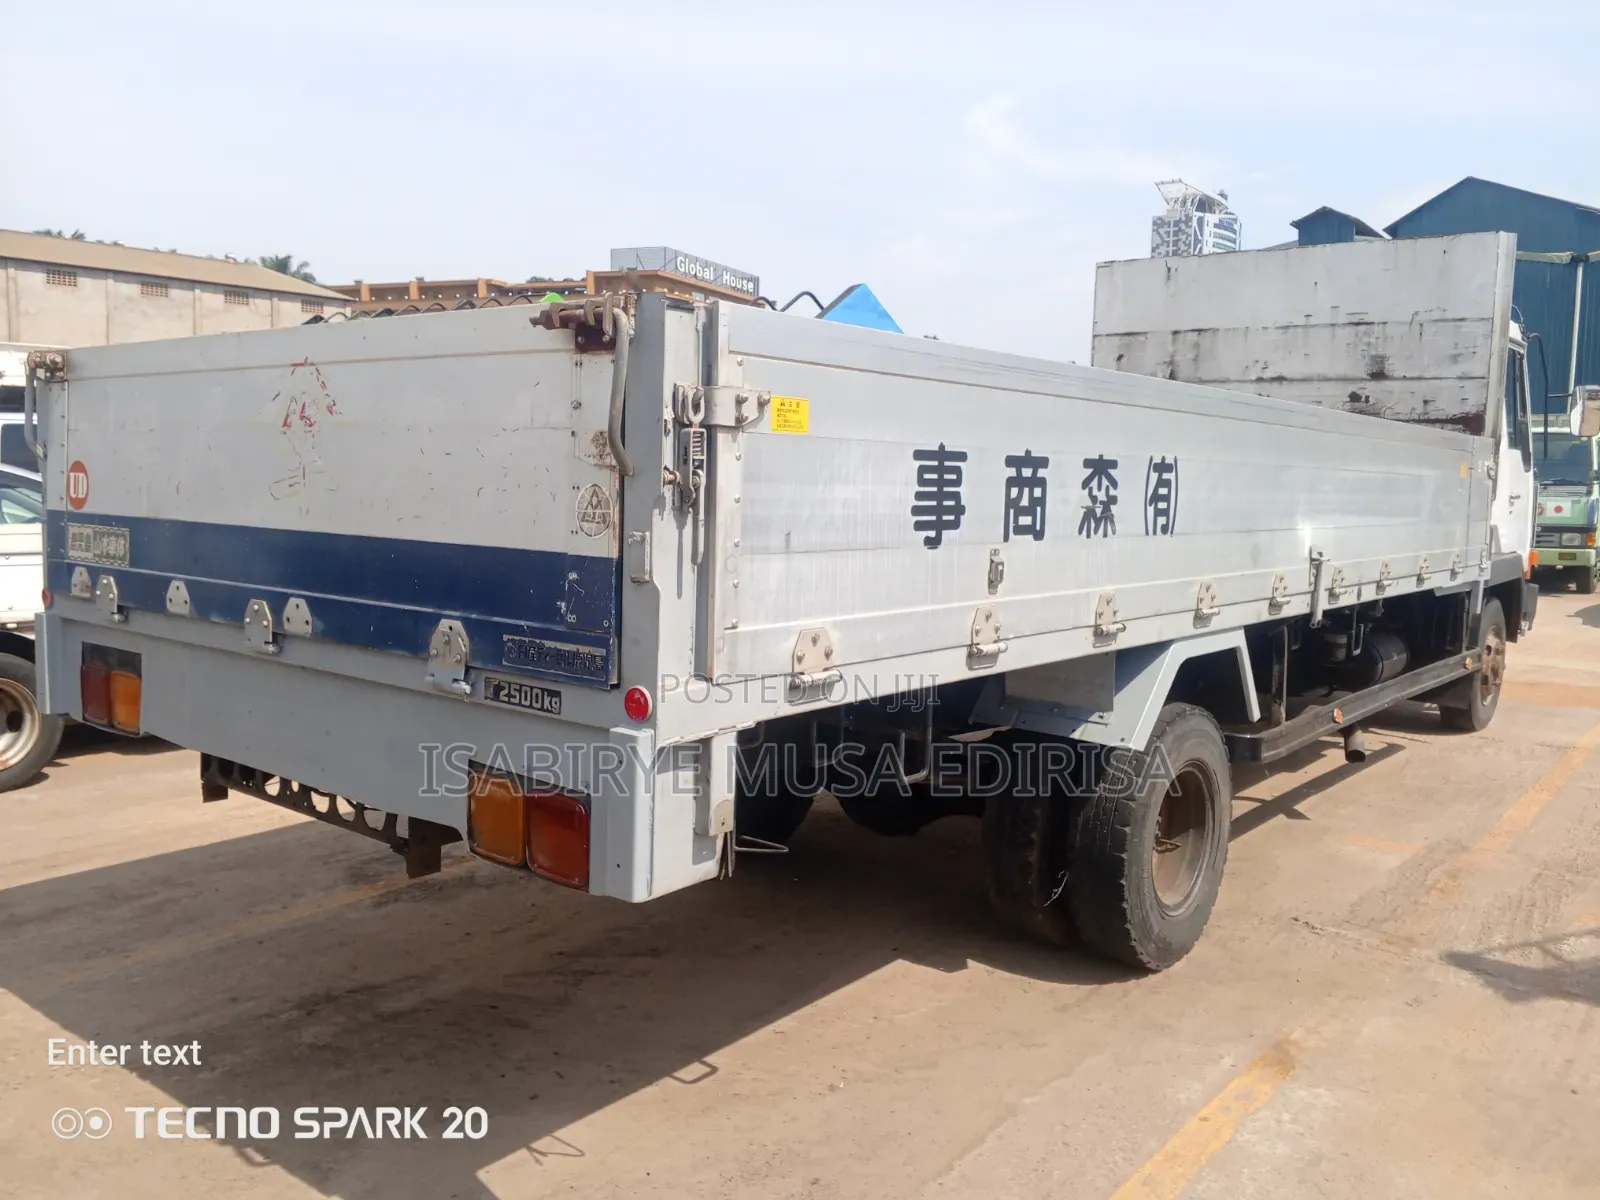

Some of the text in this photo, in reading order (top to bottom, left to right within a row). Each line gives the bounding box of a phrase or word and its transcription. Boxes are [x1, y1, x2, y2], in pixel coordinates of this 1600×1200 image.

[676, 256, 754, 293] Global House
[69, 472, 88, 498] UD
[499, 681, 561, 714] 2500kg
